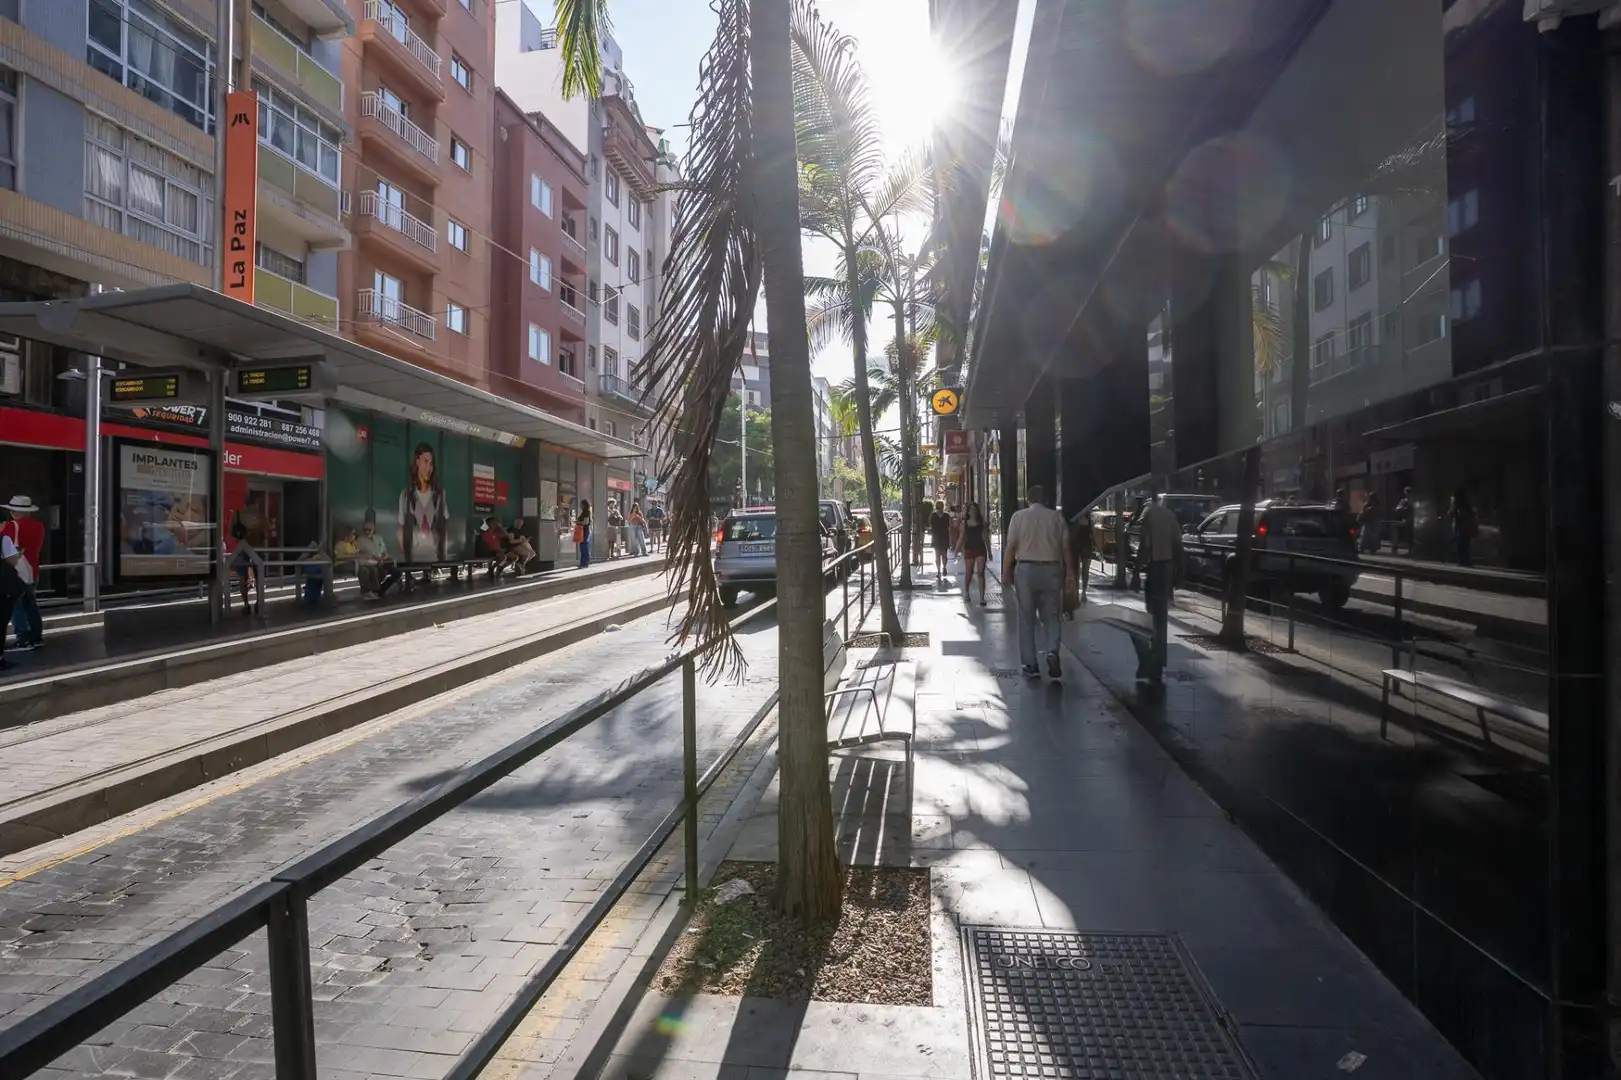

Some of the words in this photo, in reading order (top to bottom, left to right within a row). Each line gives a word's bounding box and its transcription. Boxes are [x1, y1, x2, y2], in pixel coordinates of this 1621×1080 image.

[230, 209, 247, 251] Paz
[230, 261, 245, 289] La
[196, 407, 207, 425] 7
[227, 412, 243, 423] 900
[243, 415, 258, 426] 922
[259, 418, 272, 428] 281
[132, 452, 198, 471] IMPLANTES
[995, 954, 1092, 971] UNELCO
